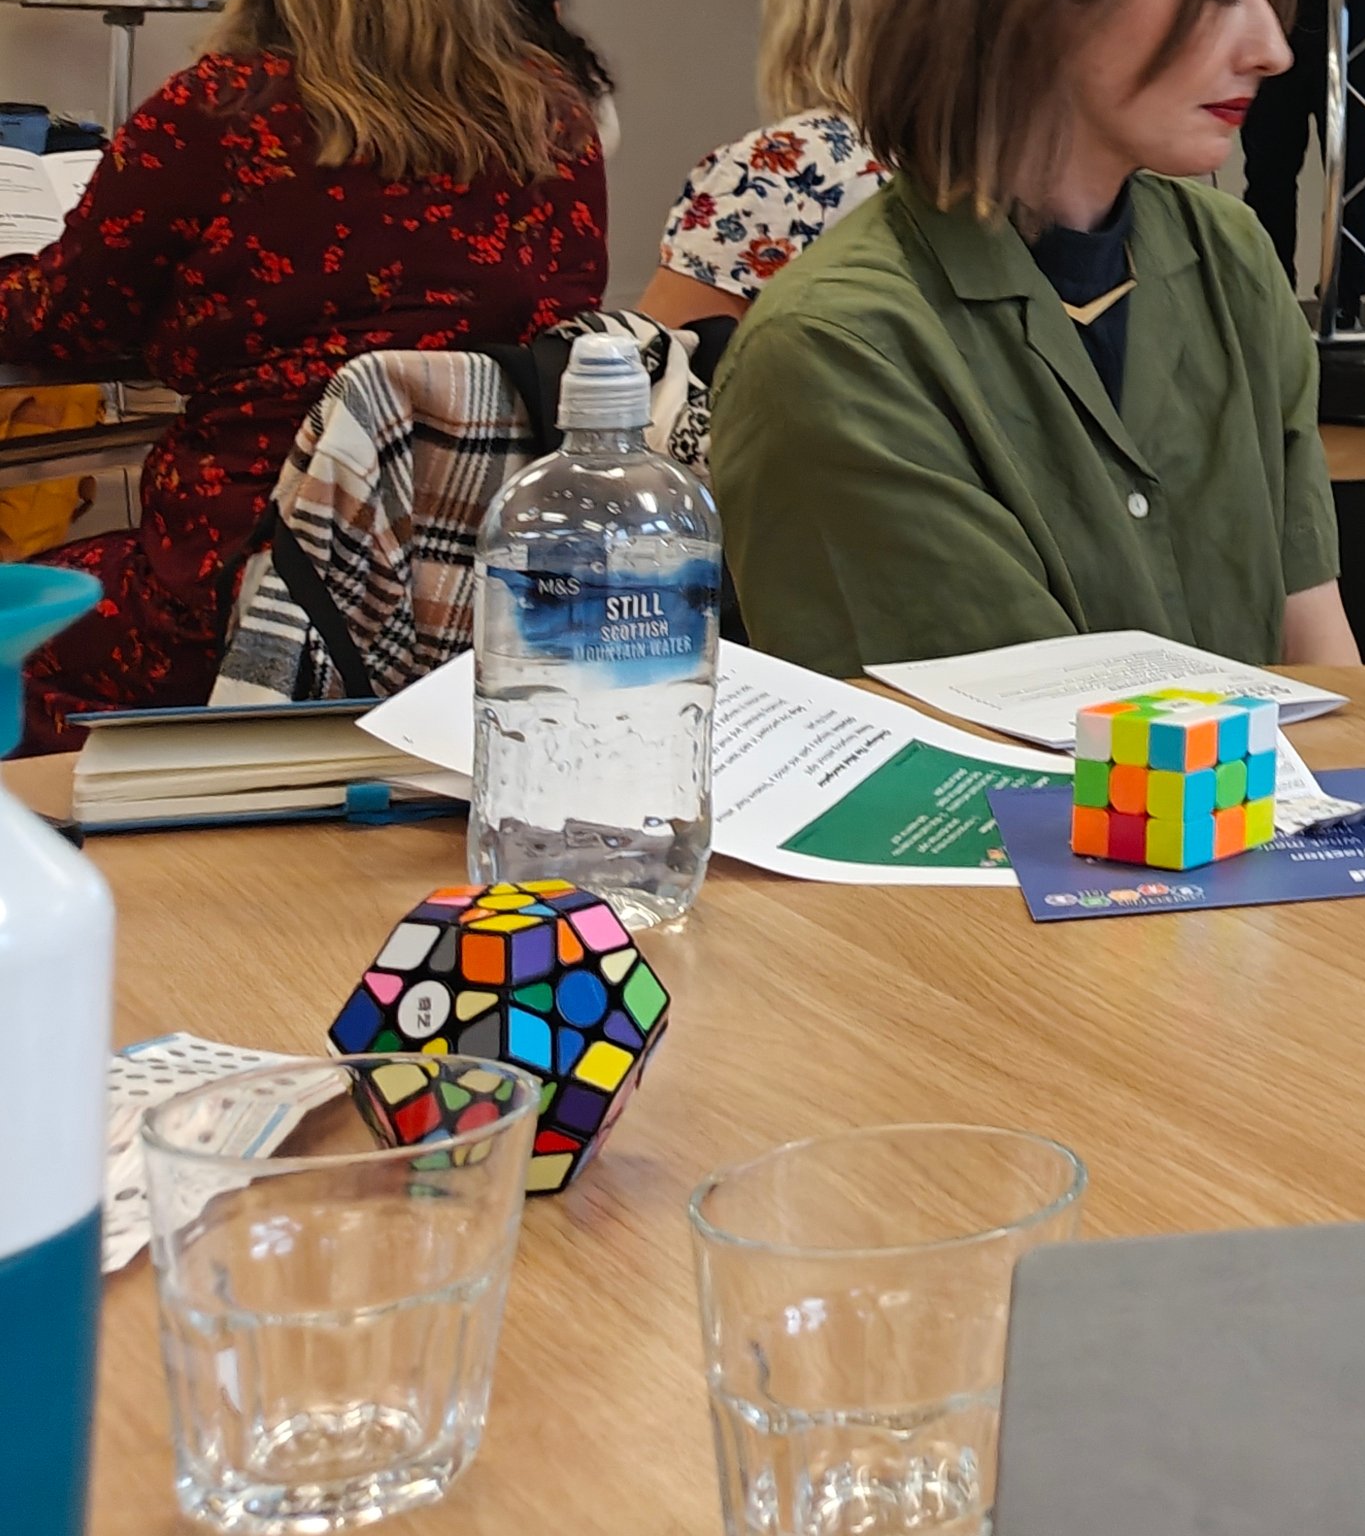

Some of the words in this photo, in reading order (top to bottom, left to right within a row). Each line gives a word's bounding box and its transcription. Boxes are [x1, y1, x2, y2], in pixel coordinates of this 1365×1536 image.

[538, 577, 581, 596] M&S
[606, 592, 664, 621] STILL
[601, 618, 669, 643] SCOTTISH
[650, 634, 693, 657] WATER
